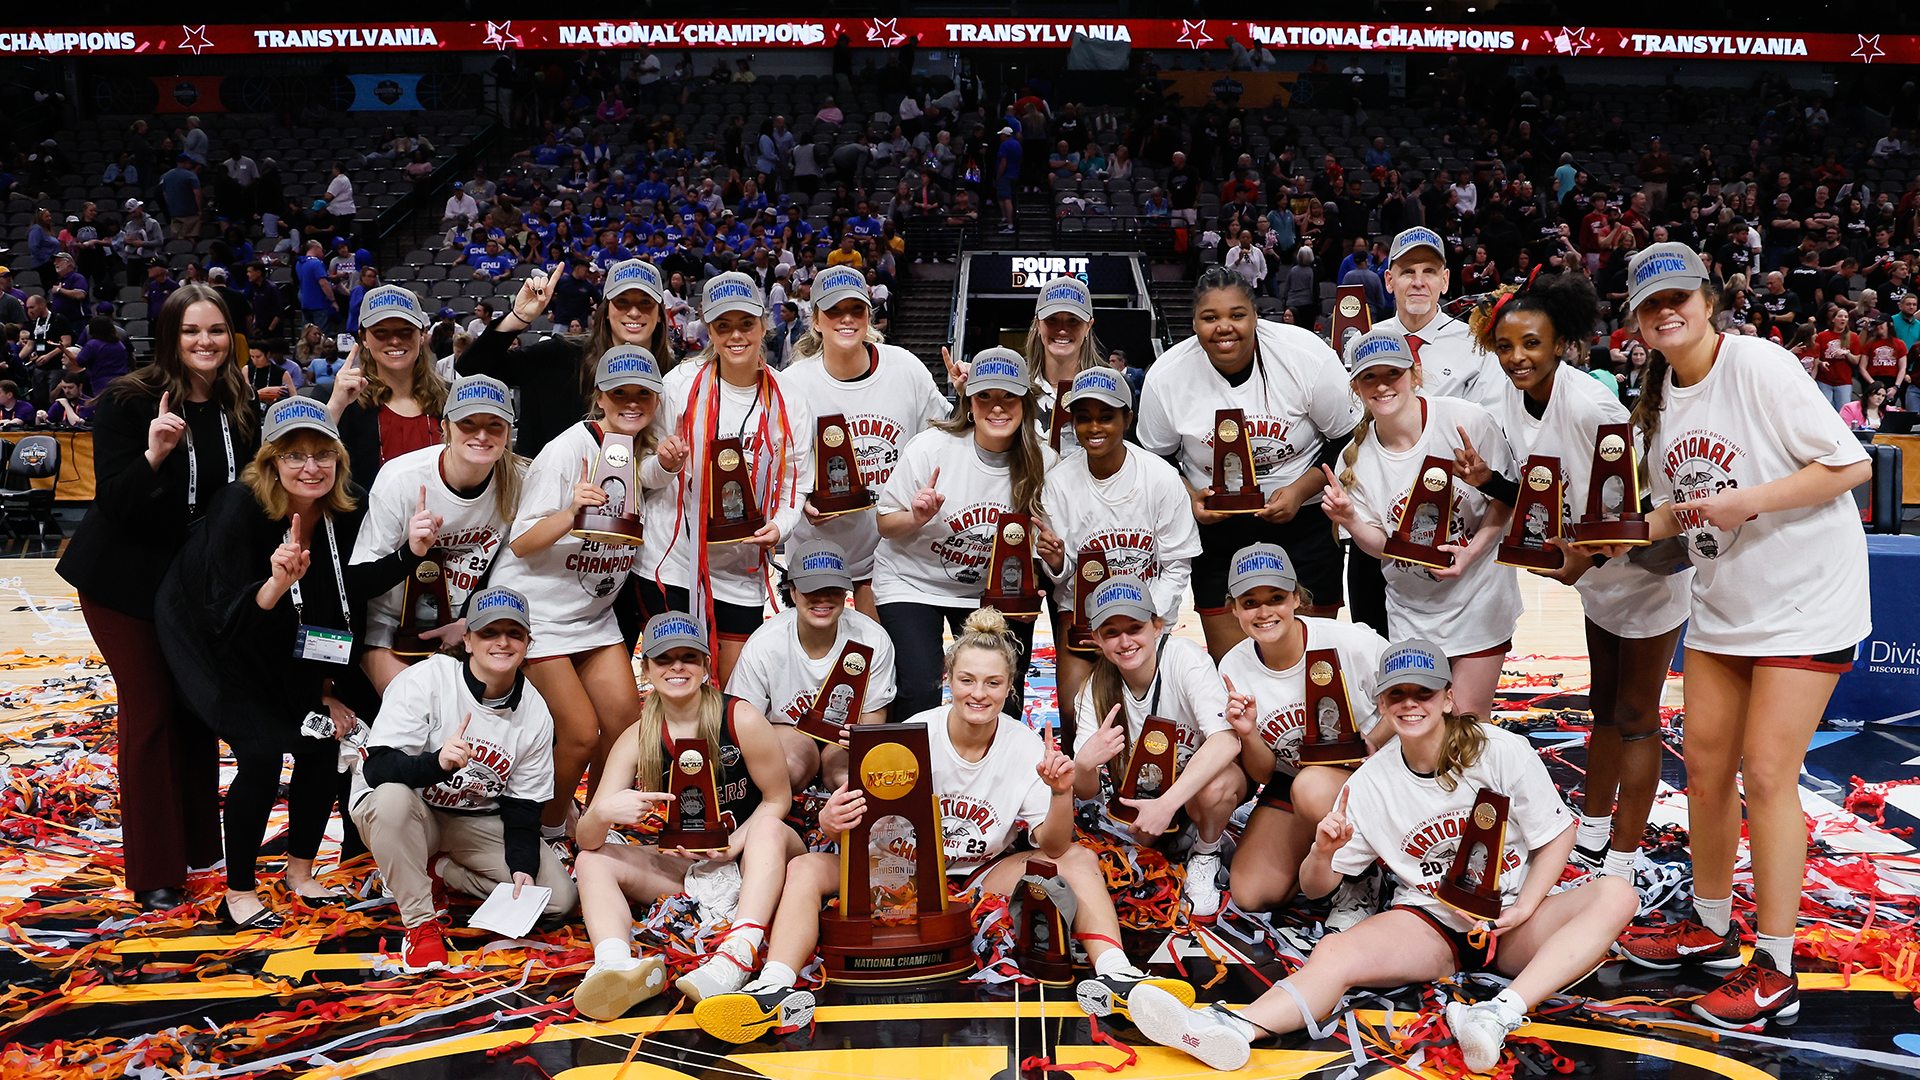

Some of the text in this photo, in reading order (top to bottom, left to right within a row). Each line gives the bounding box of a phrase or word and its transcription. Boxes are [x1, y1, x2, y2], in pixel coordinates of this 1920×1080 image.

[0, 31, 136, 51] CHAMPIONS
[254, 28, 438, 49] TRANSYLVANIA
[558, 23, 825, 46] NATIONAL CHAMPIONS
[945, 23, 1132, 43] TRANSYLVANIA
[1254, 25, 1515, 49] NATIONAL CHAMPIONS
[1631, 34, 1808, 55] TRANSYLVANIA
[1400, 231, 1440, 249] CHAMPIONS
[481, 261, 500, 269] CNU
[1011, 257, 1089, 273] FOUR IT
[1635, 258, 1687, 286] CHAMPIONS
[614, 267, 656, 286] CHAMPIONS
[822, 275, 864, 292] CHAMPIONS
[710, 284, 753, 303] CHAMPIONS
[1045, 288, 1085, 305] CHAMPIONS
[369, 294, 414, 312] CHAMPIONS
[1355, 340, 1401, 363] CHAMPIONS
[608, 358, 653, 375] CHAMPIONS
[975, 362, 1019, 378] CHAMPIONS
[1074, 378, 1116, 393] CHAMPIONS
[457, 386, 505, 404] CHAMPIONS
[274, 405, 326, 424] CHAMPIONS
[1276, 443, 1295, 460] 23
[1601, 446, 1622, 454] NCAA
[1709, 431, 1747, 459] BASKETBALL
[884, 449, 898, 464] 23
[1664, 436, 1736, 483] NATIONAL
[1424, 477, 1446, 487] NCAA
[950, 507, 1001, 534] NATIO
[1449, 516, 1465, 535] 23
[582, 539, 599, 552] 20
[947, 535, 993, 554] 20 TRANS
[468, 556, 489, 571] 23
[803, 556, 844, 571] CHAMPIONS
[931, 541, 991, 569] CHAMPI
[1236, 555, 1284, 576] CHAMPIONS
[477, 594, 525, 614] CHAMPIONS
[1096, 587, 1143, 608] CHAMPIONS
[653, 622, 700, 640] CHAMPIONS
[844, 661, 863, 672] NCAA
[1384, 654, 1435, 675] CHAMPIONS
[1869, 665, 1915, 675] DISCOVER
[1260, 708, 1306, 745] NATIO
[476, 738, 502, 751] WOMEN'S
[1272, 747, 1293, 759] 20
[486, 780, 505, 793] 23
[866, 770, 917, 789] NCAA
[1404, 816, 1470, 860] NATION
[1407, 821, 1427, 841] DIVISION
[966, 838, 988, 854] 23
[1420, 860, 1442, 877] 20
[854, 953, 943, 968] NATIONAL CHAMPION
